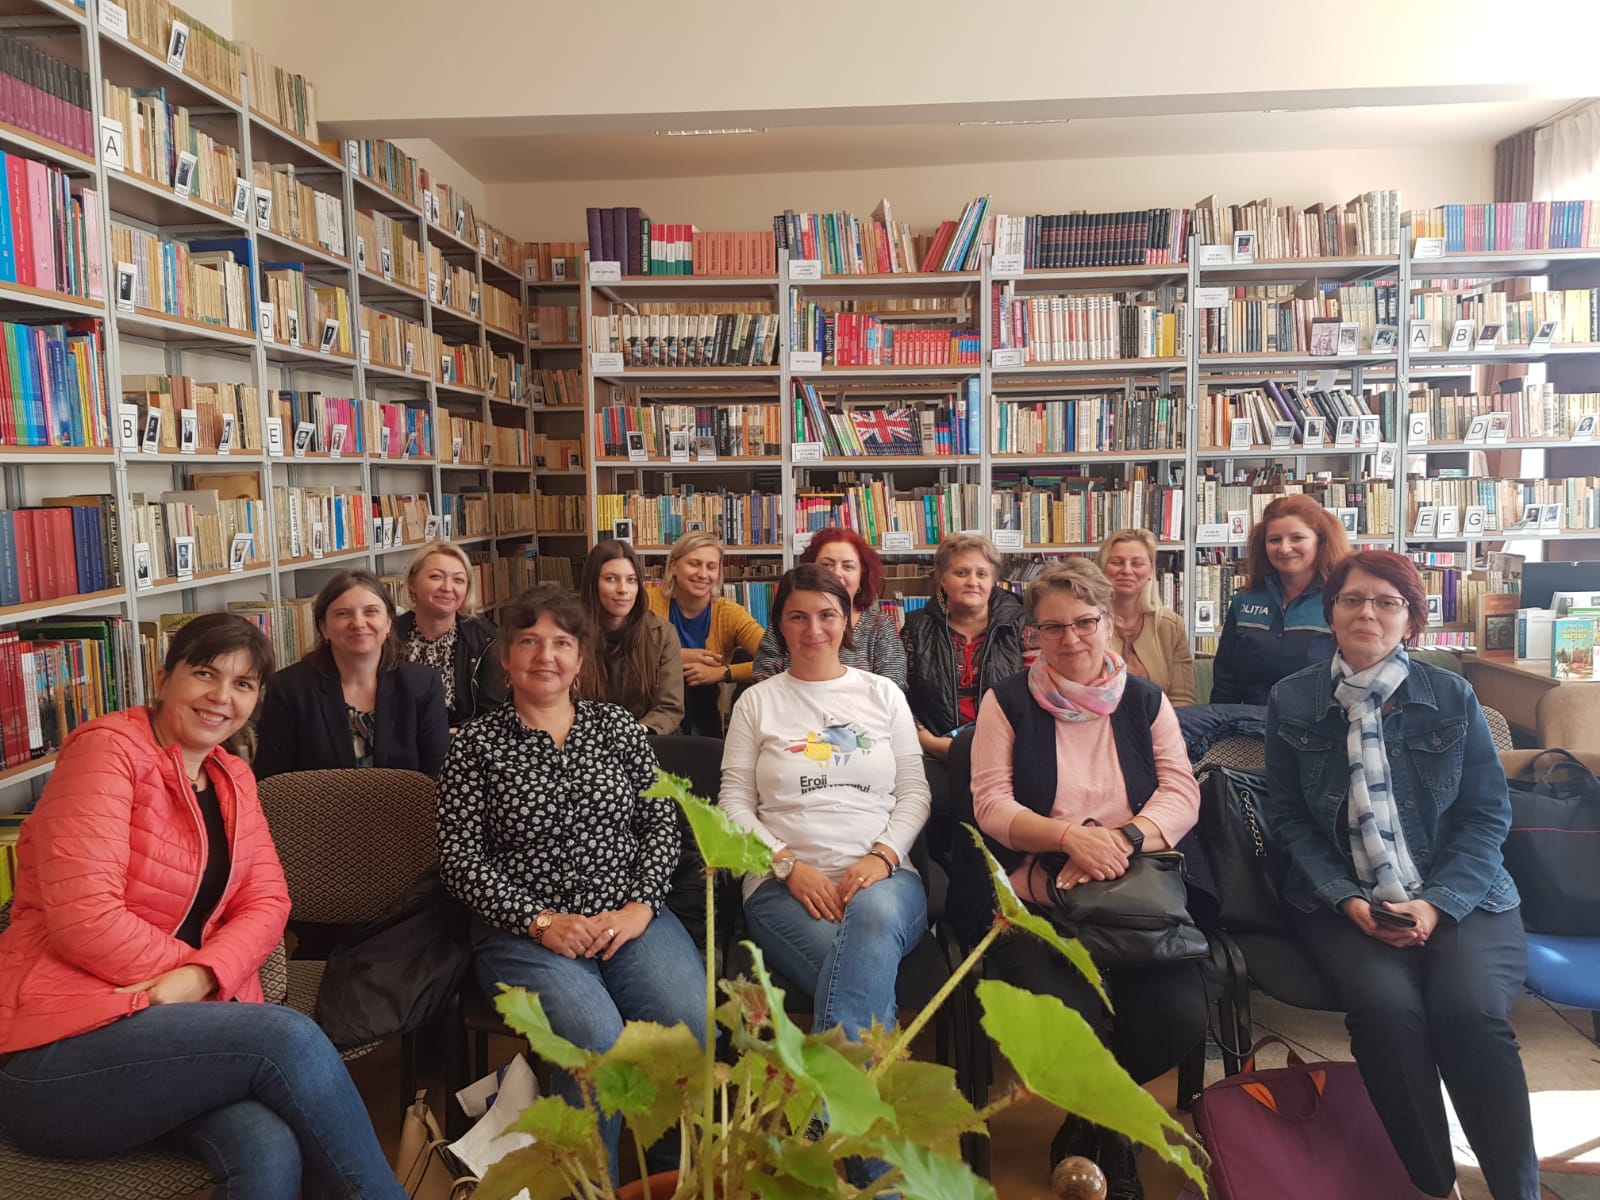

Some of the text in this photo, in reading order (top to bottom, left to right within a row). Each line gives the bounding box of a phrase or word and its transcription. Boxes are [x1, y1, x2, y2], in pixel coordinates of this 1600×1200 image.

[105, 135, 119, 157] A
[777, 218, 787, 249] LONGMA
[262, 313, 270, 329] D
[825, 324, 834, 353] English
[1414, 328, 1426, 342] A
[1456, 328, 1467, 341] B
[123, 419, 133, 438] B
[1412, 421, 1424, 435] C
[1472, 422, 1484, 434] D
[270, 428, 279, 444] E
[1420, 513, 1432, 526] E
[1442, 512, 1452, 527] F
[1468, 512, 1481, 526] G
[384, 527, 390, 541] K
[110, 516, 120, 568] HARRY POTTER
[800, 774, 827, 788] Eroii
